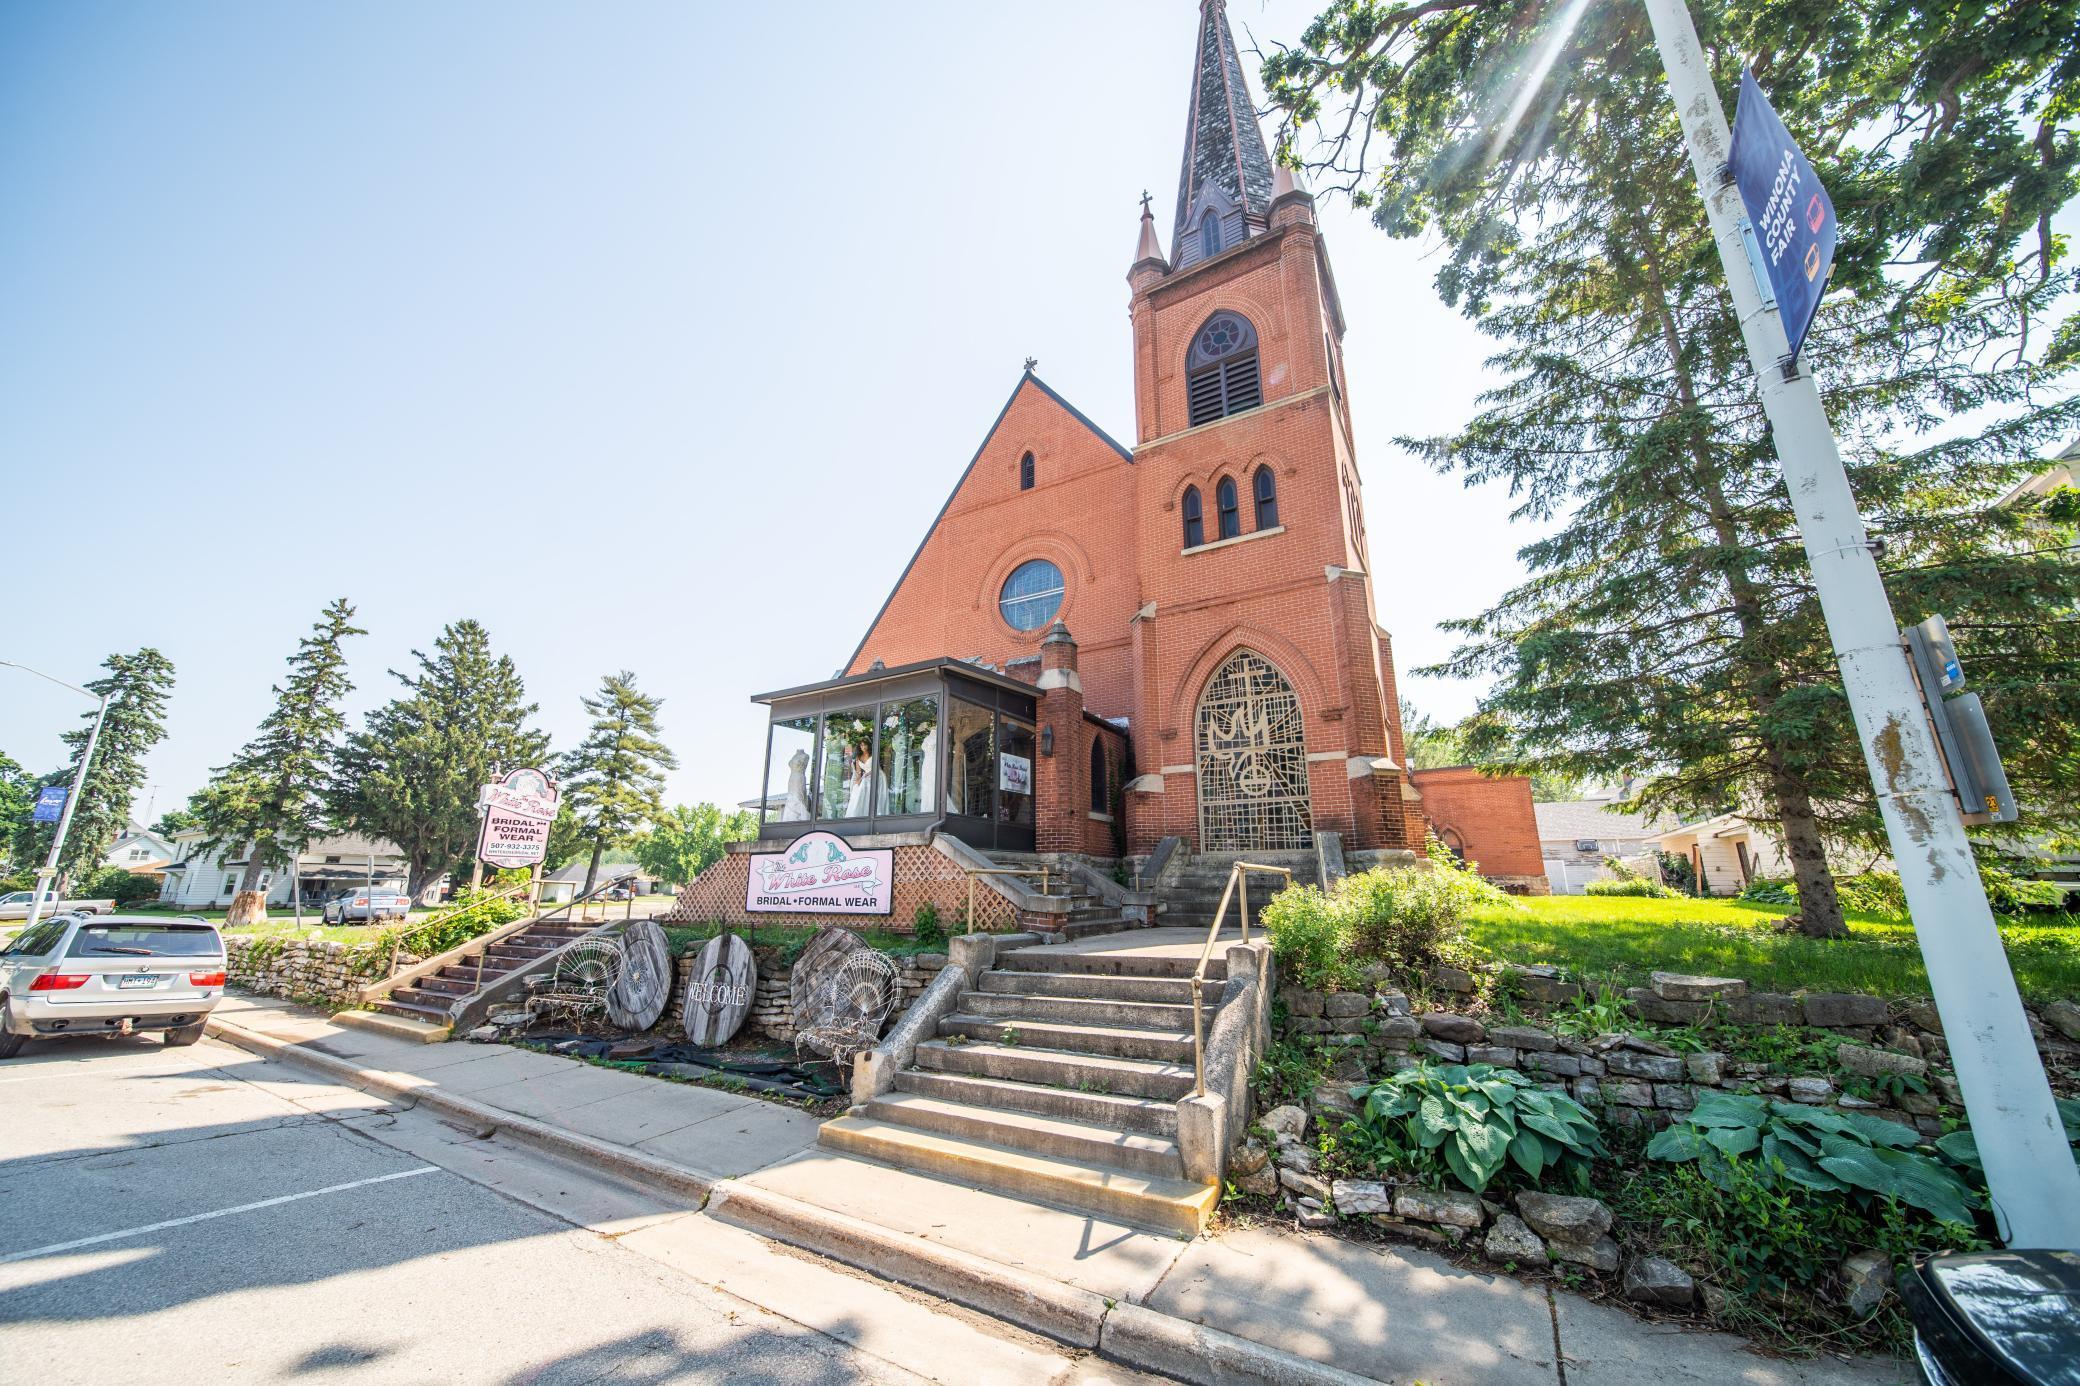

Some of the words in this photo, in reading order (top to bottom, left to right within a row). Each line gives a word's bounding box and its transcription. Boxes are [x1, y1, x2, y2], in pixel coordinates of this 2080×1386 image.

[1759, 149, 1794, 231] WINONA
[1766, 164, 1801, 249] COUNTY
[1771, 218, 1797, 267] FAIR
[488, 788, 522, 809] White
[522, 799, 556, 817] Rose
[491, 817, 535, 827] BRIDAL
[493, 826, 543, 835] FORMAL
[490, 842, 540, 850] 507-932-3375
[500, 834, 534, 842] WEAR
[768, 872, 818, 891] White
[822, 864, 873, 884] Rose
[756, 896, 792, 906] BRIDAL
[798, 896, 842, 907] FORMAL
[844, 897, 878, 907] WEAR
[688, 981, 746, 1006] WELCOME
